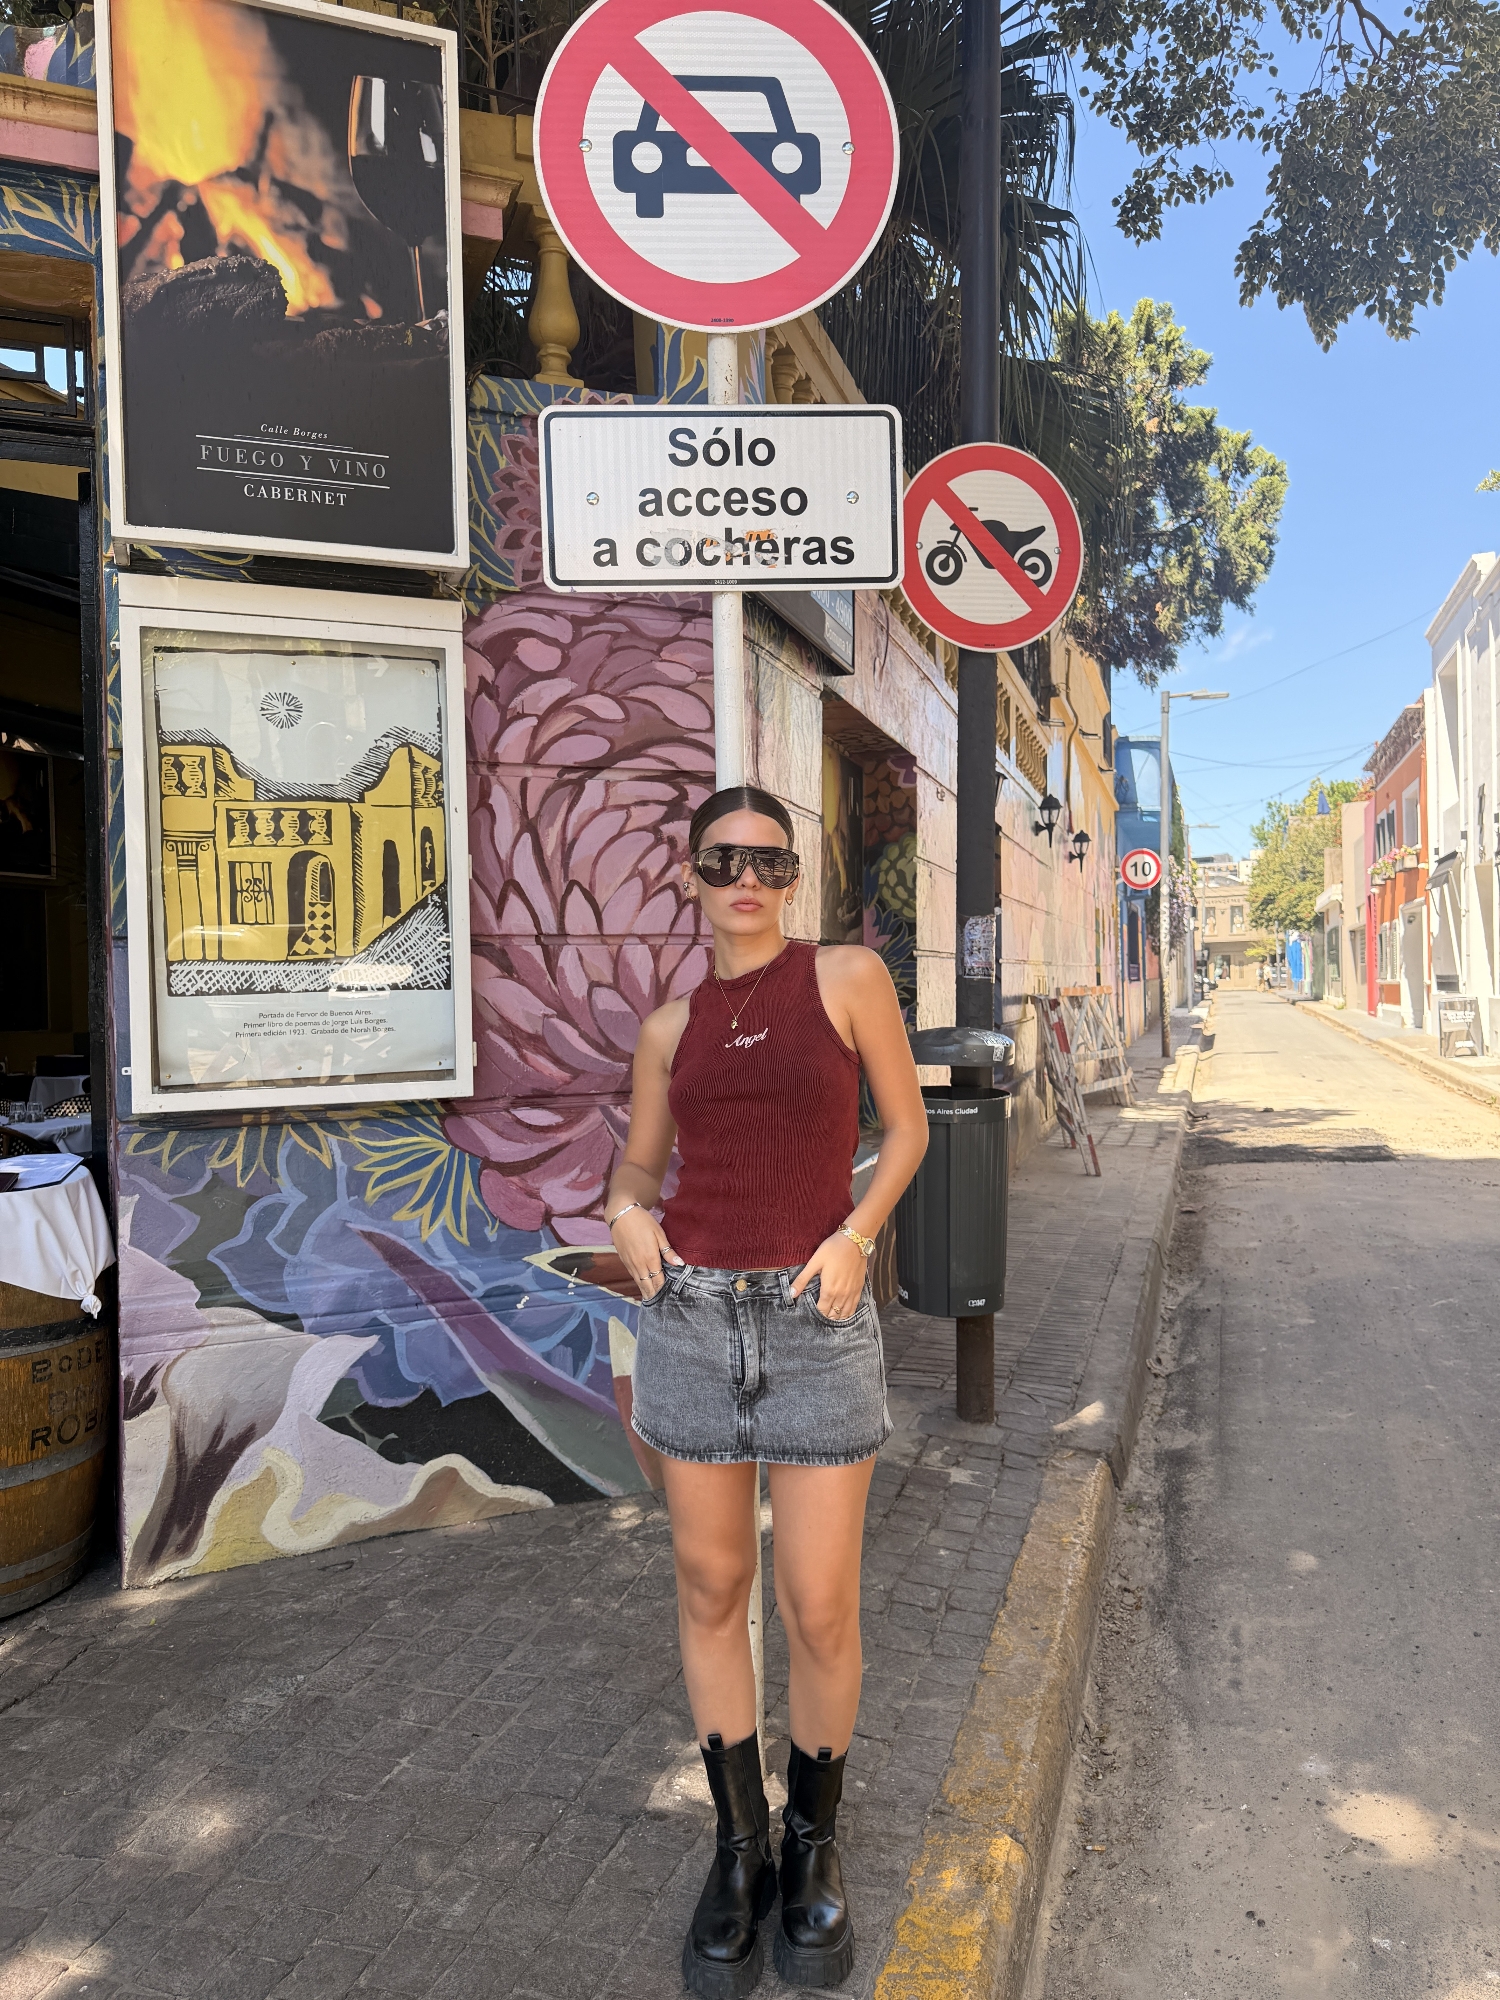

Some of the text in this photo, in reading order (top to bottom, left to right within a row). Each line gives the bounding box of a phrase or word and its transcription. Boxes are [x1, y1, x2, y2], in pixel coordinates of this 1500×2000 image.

[260, 423, 328, 440] Calle Borges
[667, 426, 776, 467] Sólo
[200, 444, 386, 479] FUEGO Y VINO
[243, 483, 347, 506] CABERNET
[638, 486, 808, 517] acceso
[592, 527, 855, 567] a cocheras
[1130, 861, 1152, 877] 10
[235, 1030, 262, 1039] Primera
[263, 1028, 287, 1037] edición
[310, 1027, 339, 1035] Grabado
[243, 1021, 266, 1029] Primer
[267, 1020, 284, 1028] libro
[294, 1020, 321, 1028] poemas
[331, 1018, 349, 1027] Jorge
[364, 1017, 388, 1026] Borges.
[724, 1027, 769, 1049] Angel
[954, 1107, 978, 1115] Ciudad
